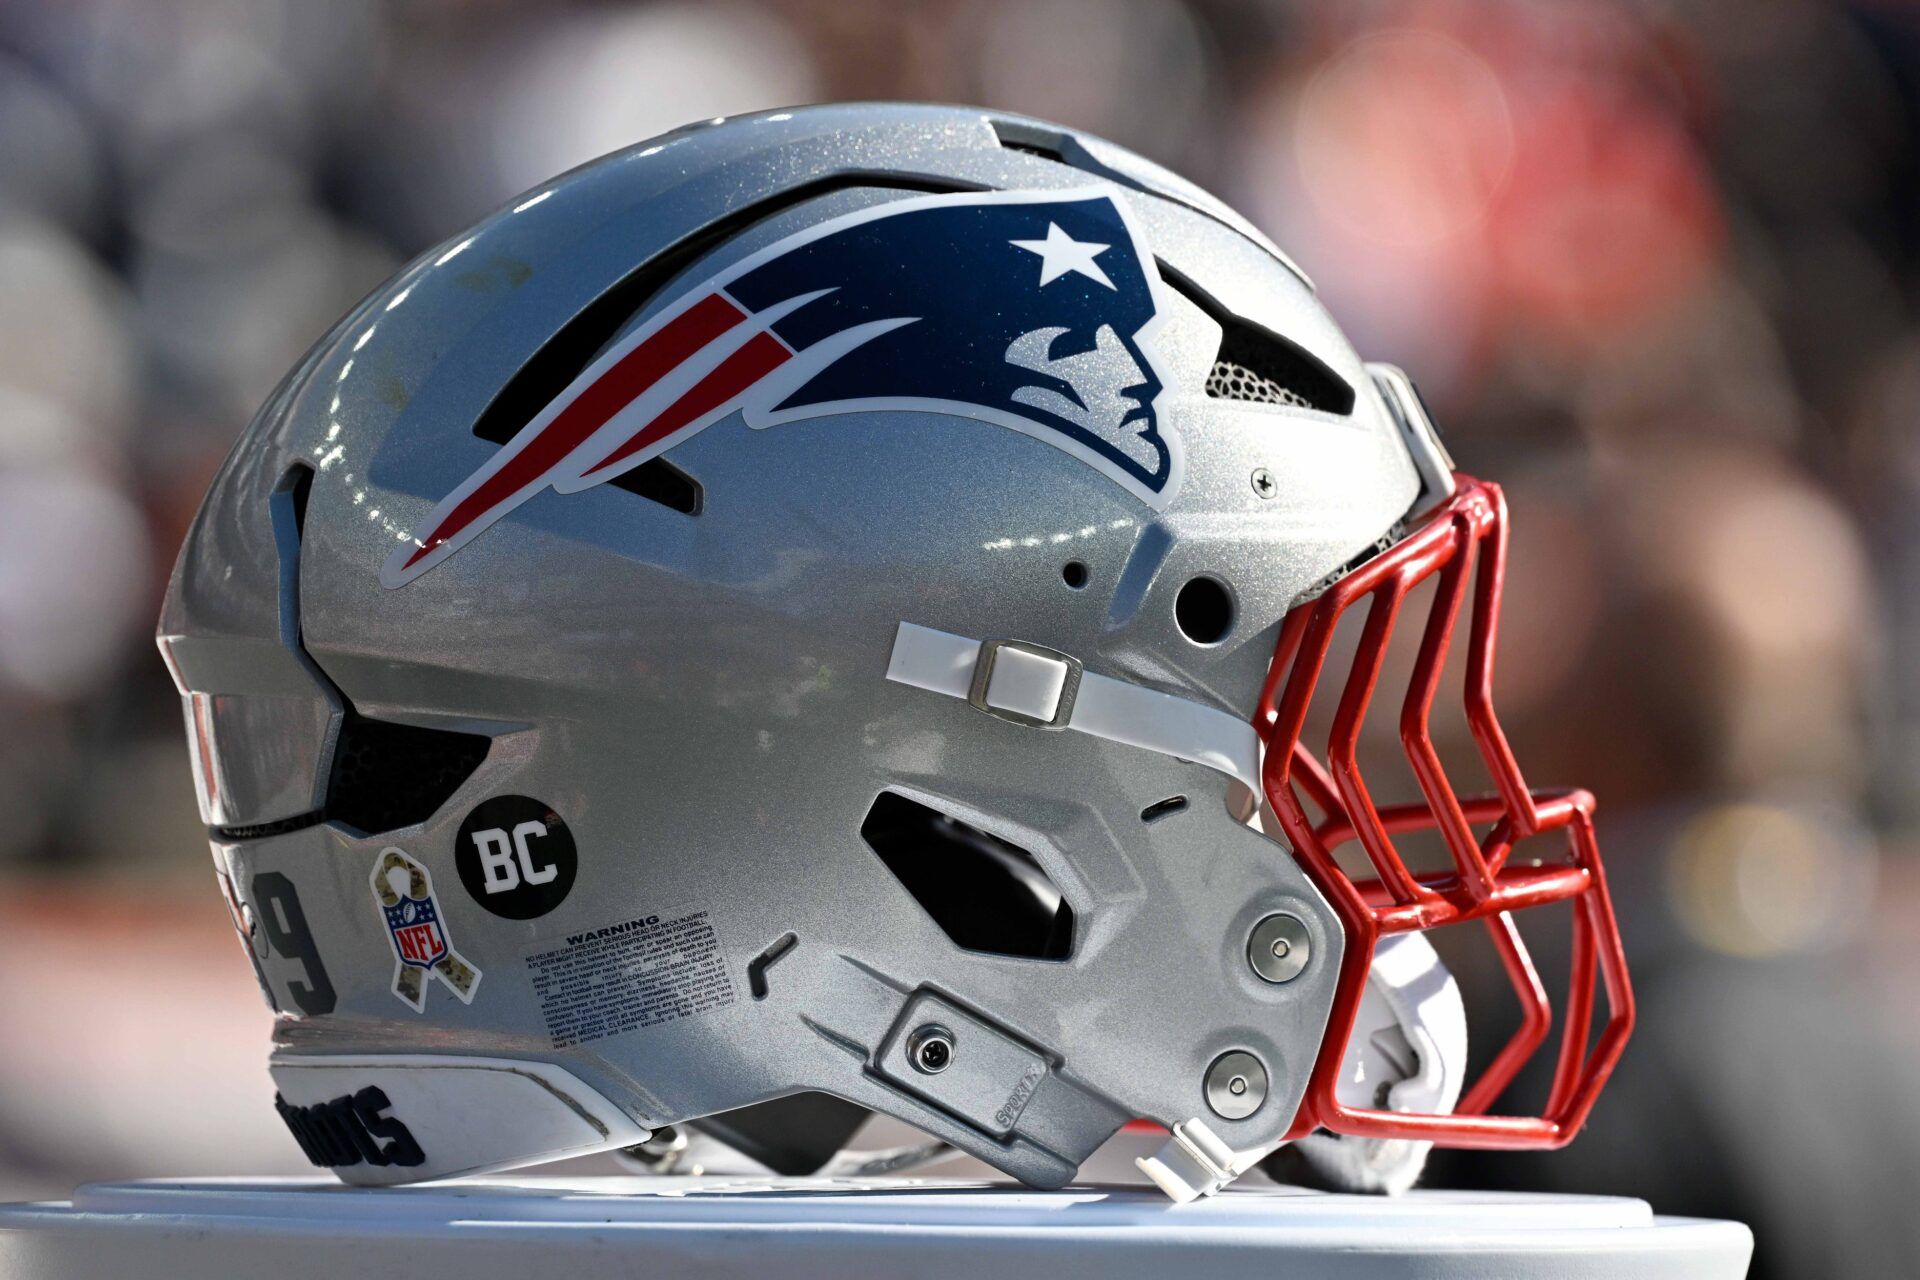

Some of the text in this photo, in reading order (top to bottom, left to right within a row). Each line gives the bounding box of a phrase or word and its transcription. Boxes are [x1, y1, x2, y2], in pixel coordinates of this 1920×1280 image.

[471, 820, 558, 895] BC
[252, 872, 337, 1016] 9
[396, 924, 444, 961] NFL
[532, 957, 555, 968] PLAYER
[574, 947, 600, 958] RECEIVE
[600, 941, 619, 952] WHILE
[620, 929, 665, 947] PARTICIPATING
[535, 949, 559, 961] HELMET
[573, 939, 602, 951] PREVENT
[603, 932, 631, 944] SERIOUS
[631, 926, 649, 937] HEAD
[660, 918, 678, 929] NECK
[678, 910, 708, 924] INJURIES
[565, 914, 660, 945] WARNING
[690, 952, 713, 964] INJURY
[577, 1023, 607, 1036] MEDICAL
